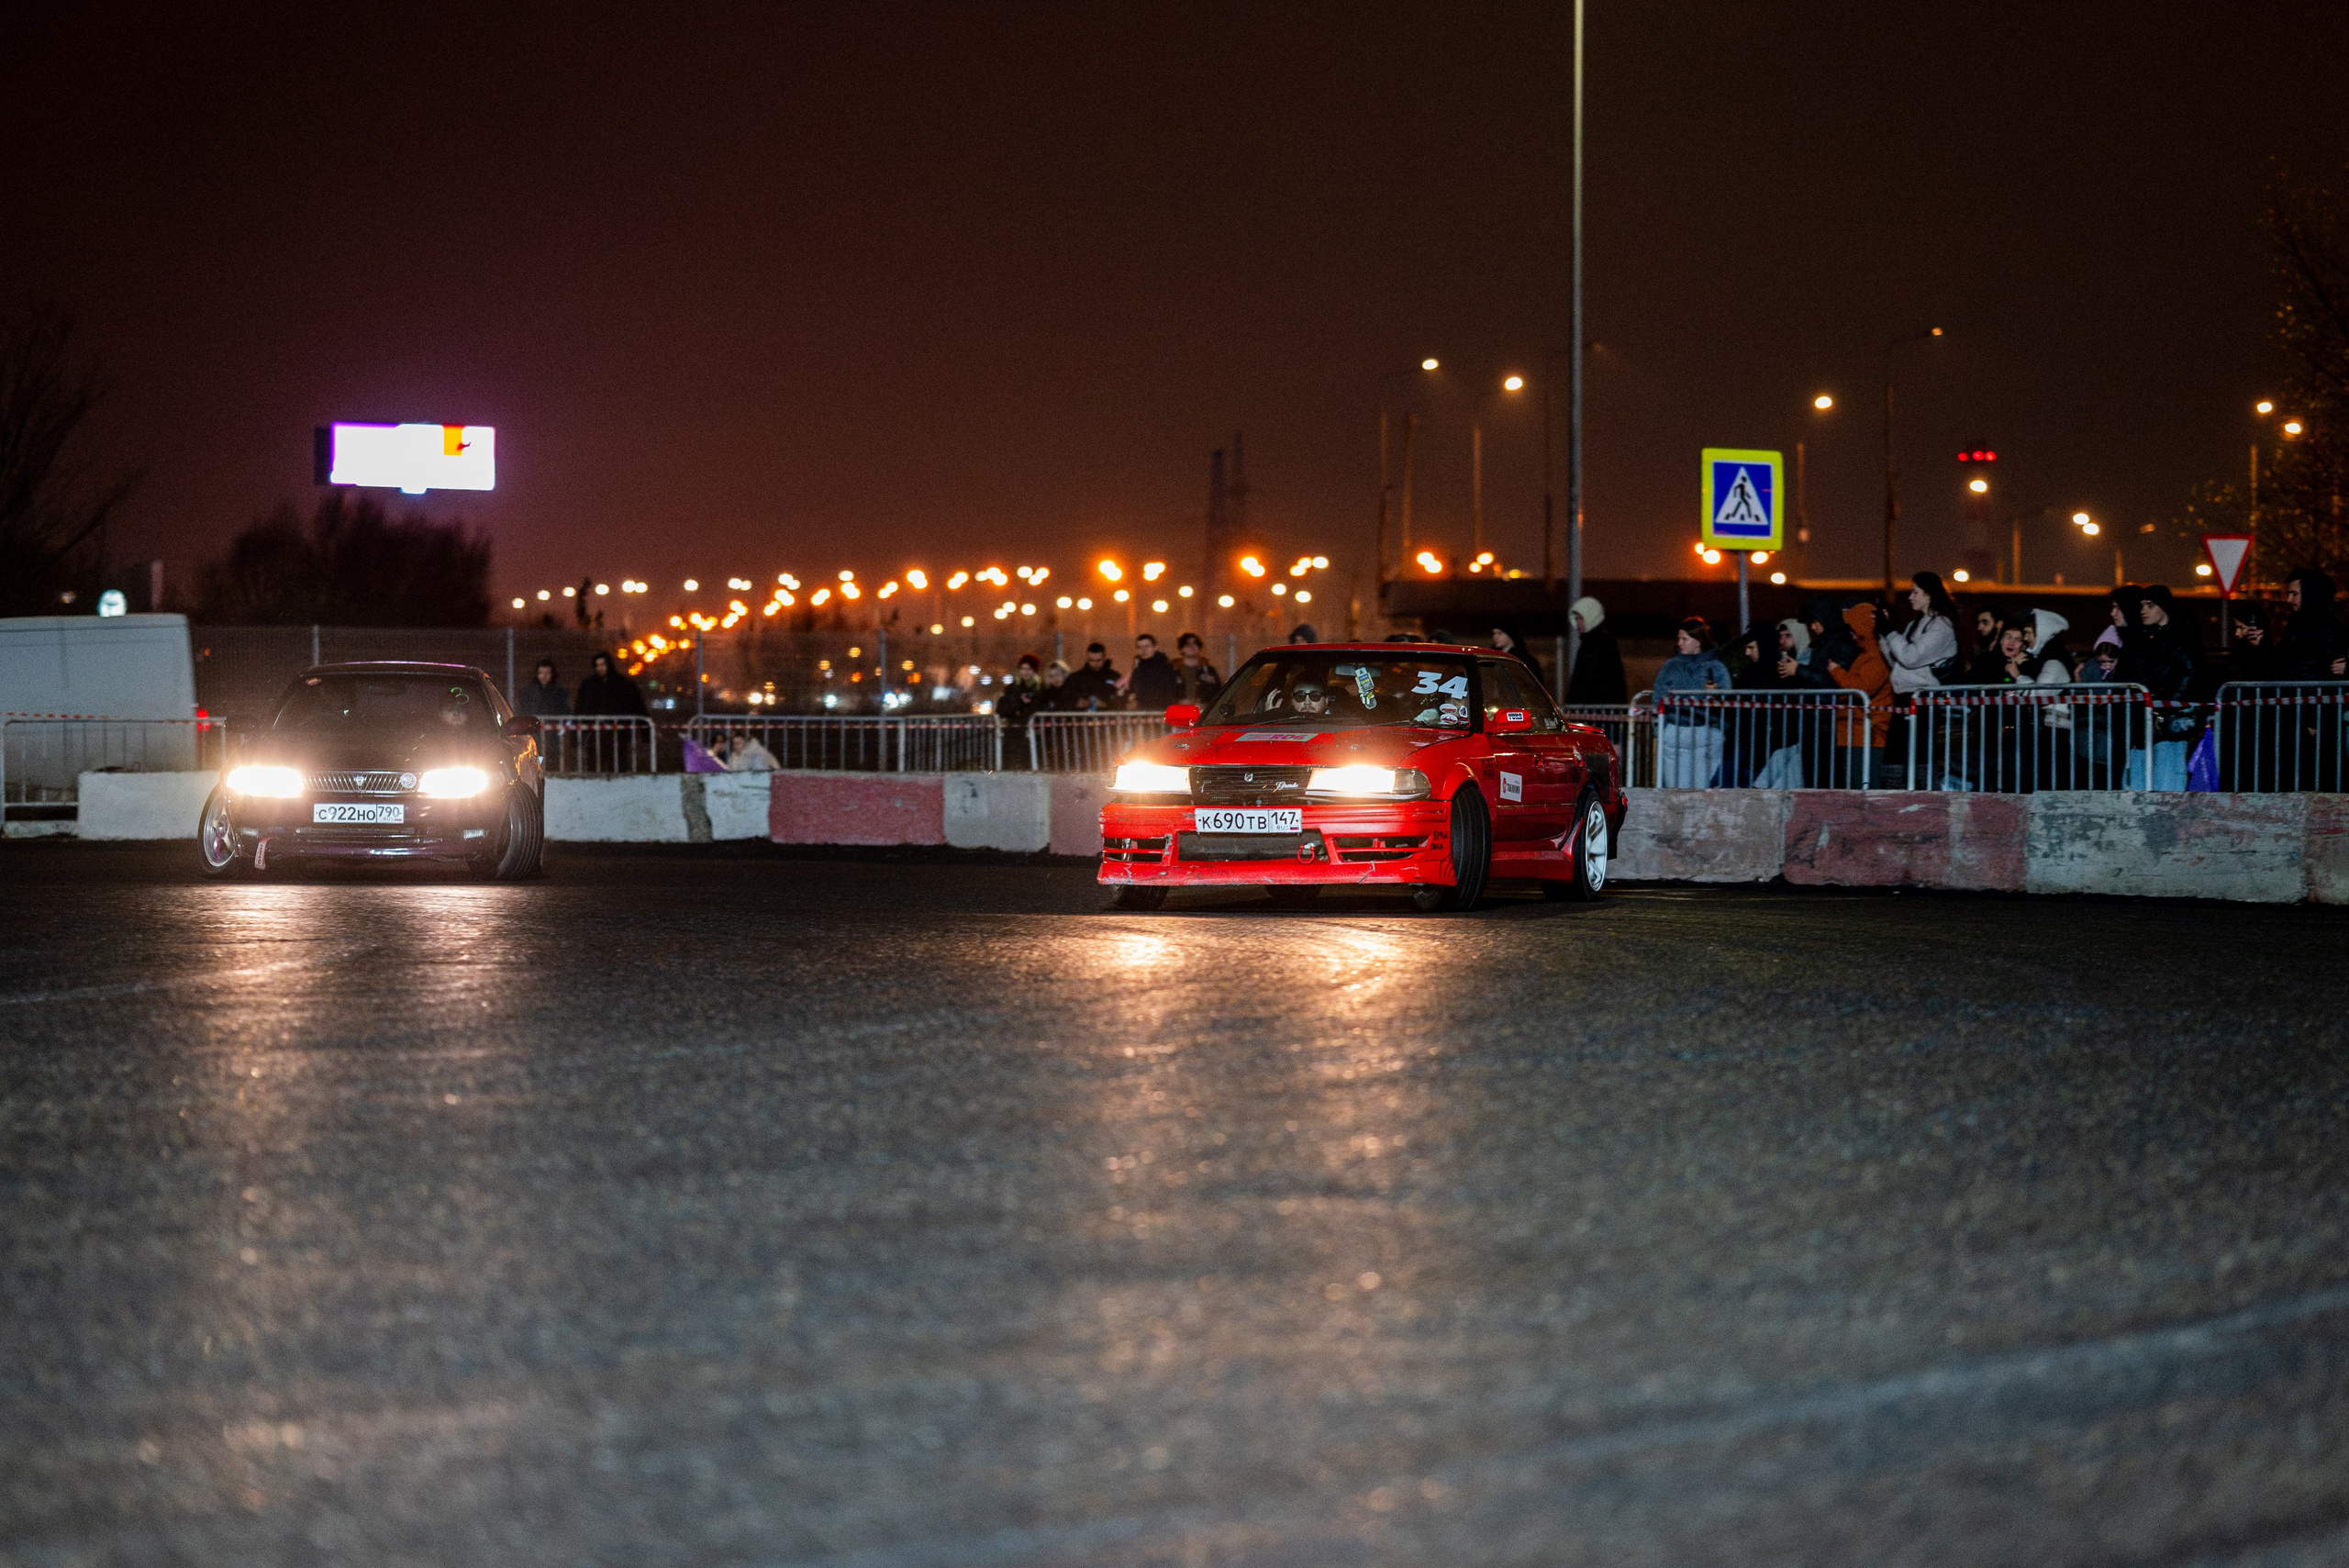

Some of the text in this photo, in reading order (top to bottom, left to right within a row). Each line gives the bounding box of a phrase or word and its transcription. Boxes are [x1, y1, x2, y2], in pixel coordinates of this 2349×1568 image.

[1411, 671, 1468, 699] 34
[318, 806, 400, 821] С922НО 790
[1202, 811, 1297, 829] К690ТВ 147
